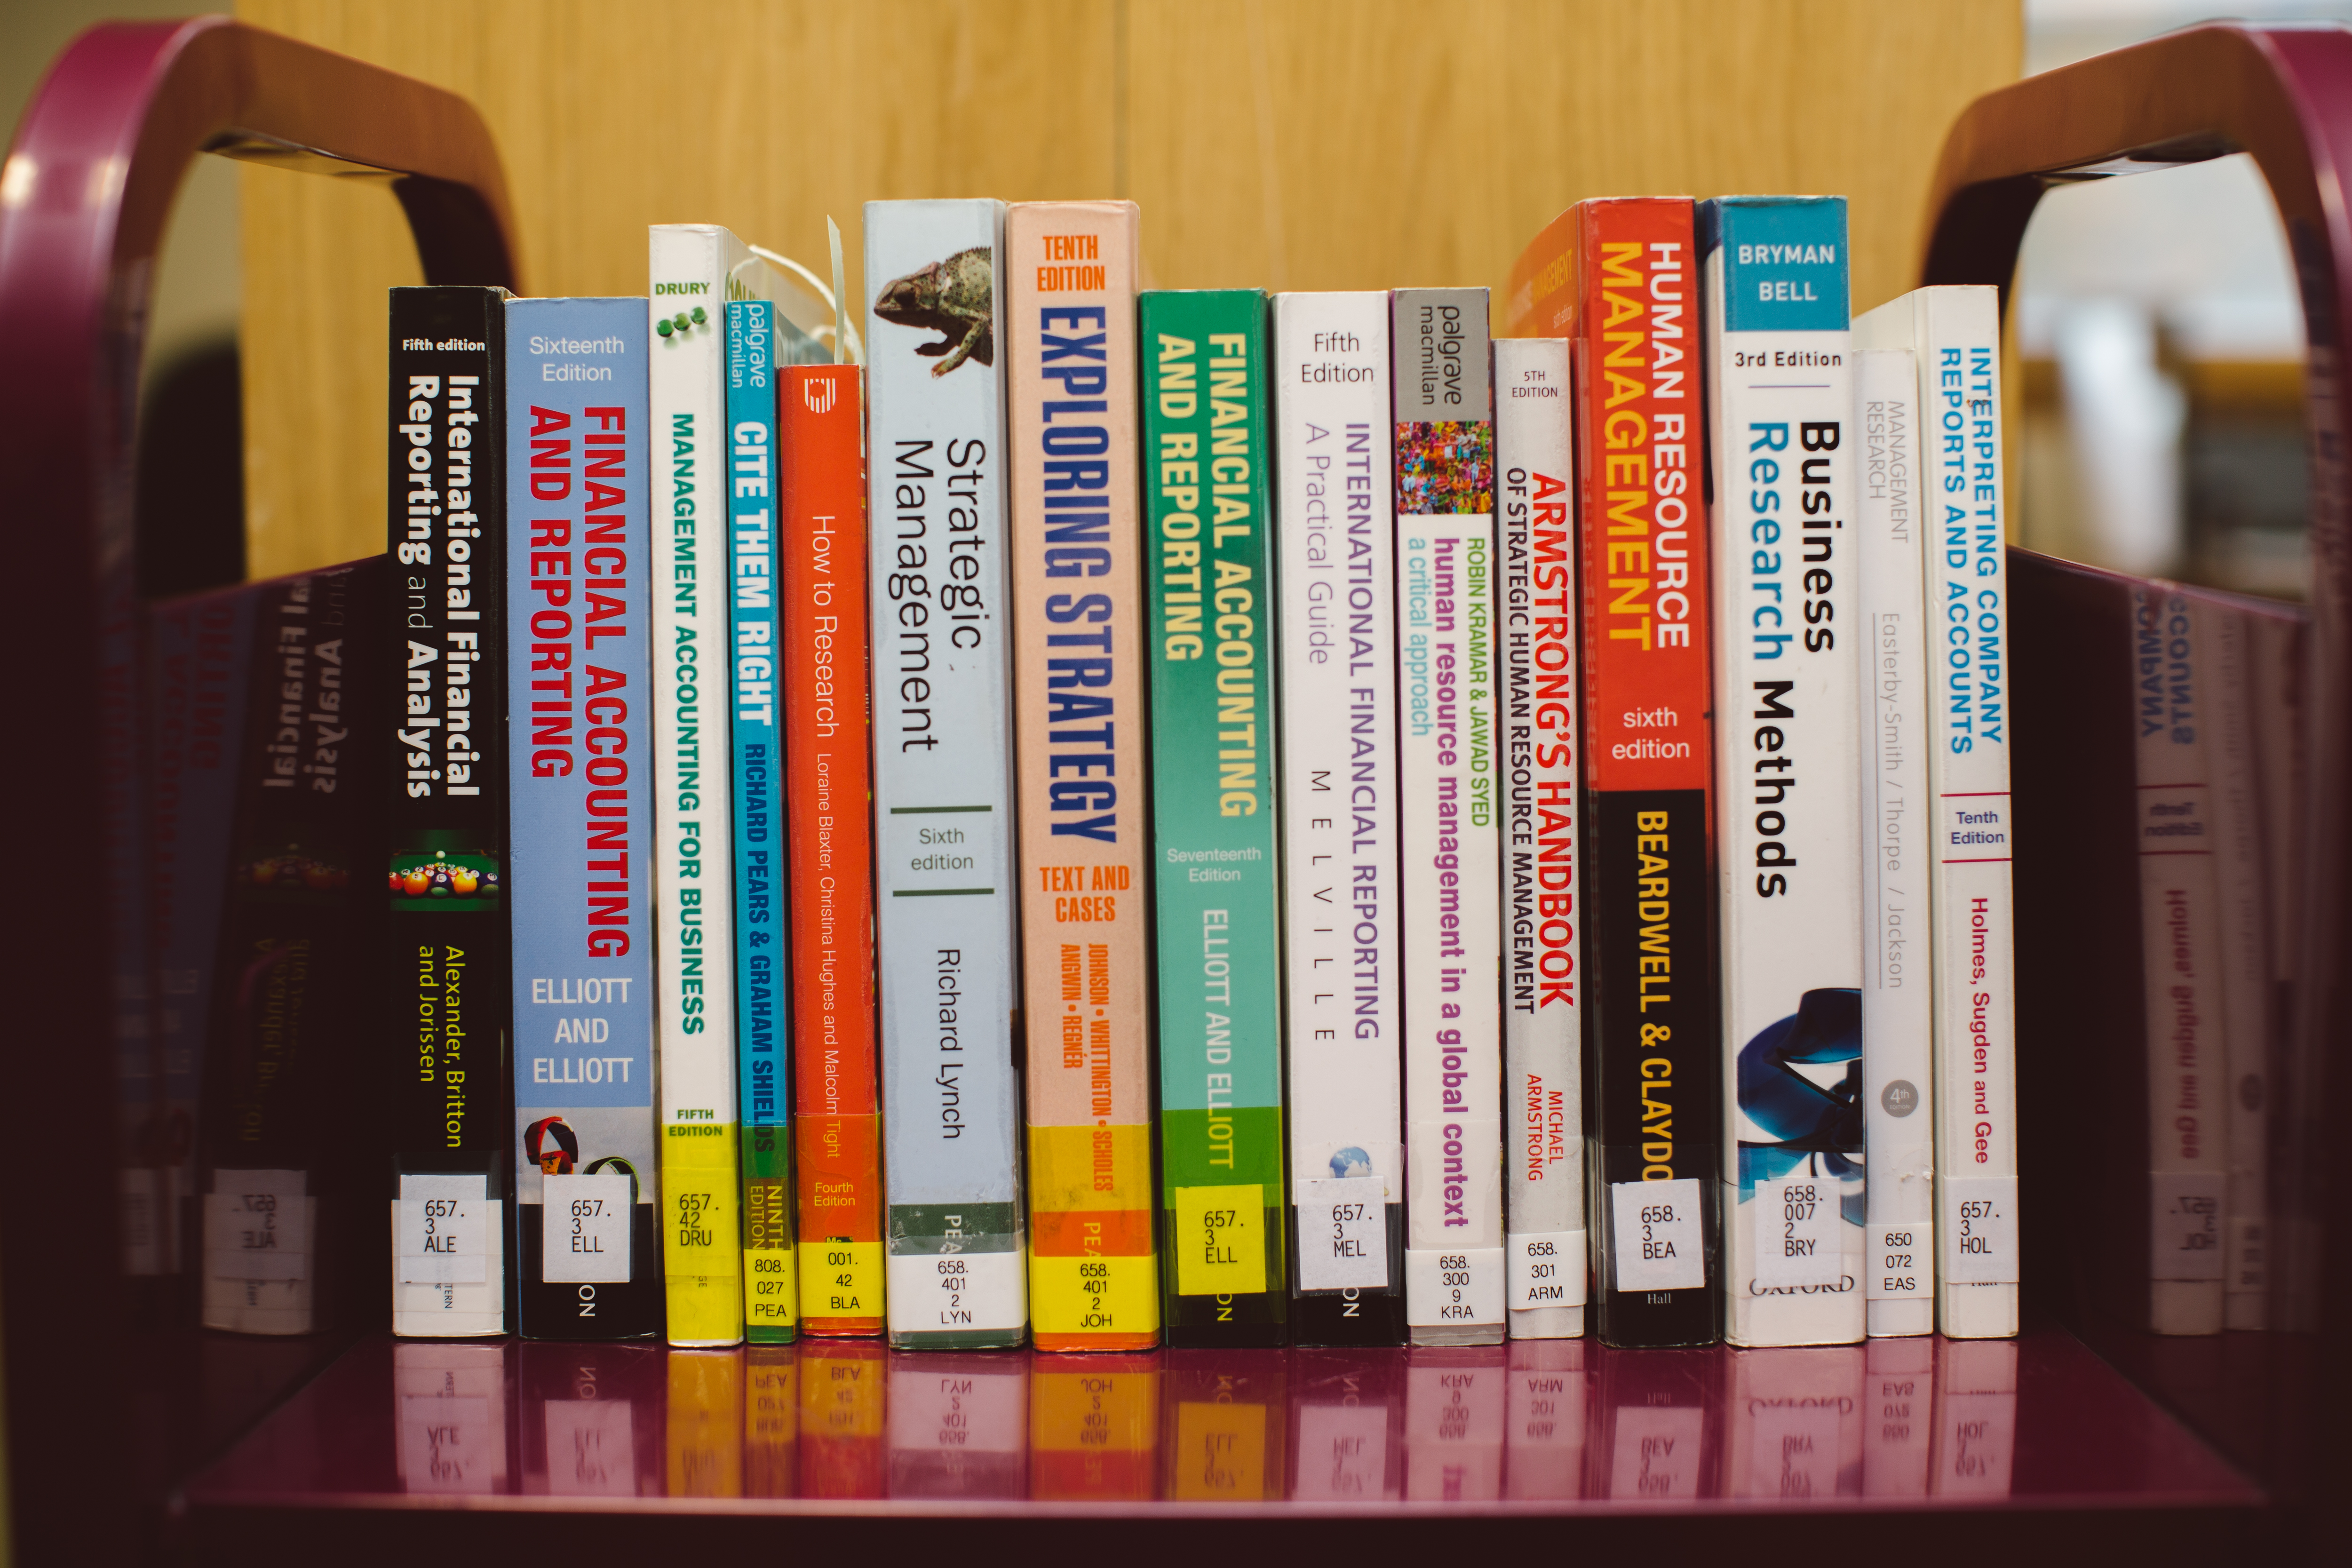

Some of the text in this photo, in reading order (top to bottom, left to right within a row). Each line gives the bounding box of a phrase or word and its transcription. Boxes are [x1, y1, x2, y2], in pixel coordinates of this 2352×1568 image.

[1042, 235, 1098, 261] TENTH
[1739, 245, 1835, 264] BRYMAN
[1037, 266, 1105, 292] EDITION
[656, 283, 710, 295] DRURY
[1759, 282, 1818, 302] BELL
[403, 339, 485, 351] Fifth edition
[530, 336, 624, 355] Sixteenth
[1314, 332, 1359, 352] Fifth
[1420, 306, 1438, 405] macmillan
[1438, 305, 1465, 405] palgrave
[1735, 351, 1842, 367] 3rd Edition
[542, 363, 612, 382] Edition
[1302, 363, 1374, 383] Edition
[1524, 371, 1545, 381] 5TH
[1512, 387, 1558, 398] EDITION
[1601, 242, 1651, 651] MANAGEMENT
[1650, 242, 1690, 648] HUMAN RESOURCE
[941, 438, 990, 649] Strategic
[1306, 423, 1335, 664] A Practical Guide
[1800, 422, 1843, 653] Business
[1970, 348, 2001, 744] INTERPRETING COMPANY
[1940, 348, 1972, 755] REPORTS AND ACCOUNTS
[734, 422, 771, 725] CITE THEM RIGHT
[1041, 306, 1117, 844] EXPLORING STRATEGY
[398, 376, 441, 797] Reporting and Analysis
[447, 376, 481, 795] International Financial
[530, 405, 573, 777] AND REPORTING
[889, 440, 938, 753] Management
[812, 516, 839, 737] How to Research
[1748, 422, 1796, 898] Research Methods
[584, 407, 630, 957] FINANCIAL ACCOUNTING
[1467, 538, 1490, 827] ROBIN KRAMAR & JAWAD SYED
[673, 414, 704, 1035] MANAGEMENT ACCOUNTING FOR BUSINESS
[1623, 707, 1677, 728] sixth
[1345, 423, 1379, 1040] INTERNATIONAL FINANCIAL REPORTING
[1507, 468, 1534, 1014] OF STRATEGIC HUMAN RESOURCE MANAGEMENT
[1532, 472, 1573, 1009] ARMSTRONG'S HANDBOOK
[1612, 739, 1690, 760] edition
[1955, 811, 1998, 824] Tenth
[919, 828, 964, 844] Sixth
[1951, 830, 2004, 844] Edition
[911, 854, 974, 870] edition
[1167, 847, 1262, 863] Seventeenth
[1189, 868, 1241, 883] Edition
[1433, 537, 1469, 1227] human resource management in a global context
[1637, 811, 1670, 1012] BEARDWELL
[745, 744, 775, 1152] RICHARD PEARS & GRAHAM SHIELDS
[818, 754, 841, 1158] Loraine Blaxter, Christina Hughes and Malcolm Tight
[420, 946, 439, 1082] and Jorissen
[1640, 1023, 1671, 1047] &
[1969, 898, 1991, 1163] Holmes, Sugden and Gee
[443, 945, 466, 1148] Alexander, Britton
[936, 949, 965, 1138] Richard Lynch
[1890, 1088, 1909, 1103] 4th
[677, 1109, 714, 1119] FIFTH
[669, 1126, 723, 1136] EDITION
[1527, 1074, 1543, 1181] ARMSTRONG
[1549, 1091, 1564, 1164] MICHAEL
[815, 1182, 853, 1193] Fourth
[425, 1200, 465, 1217] 657.
[680, 1194, 719, 1210] 657.
[814, 1195, 855, 1206] Edition
[1961, 1202, 1999, 1218] 657.
[680, 1211, 700, 1228] 42
[751, 1186, 764, 1250] EDITION
[767, 1186, 783, 1250] NINTH
[424, 1236, 456, 1252] ALE
[680, 1230, 712, 1246] DRU
[1885, 1233, 1911, 1247] 650
[1961, 1237, 1991, 1254] HOL
[828, 1252, 858, 1265] 001.
[1528, 1242, 1557, 1256] 658.
[755, 1259, 785, 1273] 808.
[938, 1261, 969, 1274] 658.
[1440, 1256, 1470, 1269] 658.
[1532, 1264, 1554, 1278] 301
[1886, 1255, 1911, 1268] 072
[757, 1281, 783, 1294] 027
[836, 1274, 852, 1287] 42
[942, 1277, 966, 1290] 401
[1443, 1273, 1469, 1286] 300
[1884, 1277, 1915, 1290] EAS
[1528, 1286, 1563, 1300] ARM
[1647, 1293, 1671, 1304] Hall
[755, 1304, 787, 1317] PEA
[831, 1297, 860, 1309] BLA
[1441, 1305, 1474, 1318] KRA
[941, 1311, 971, 1324] LYN
